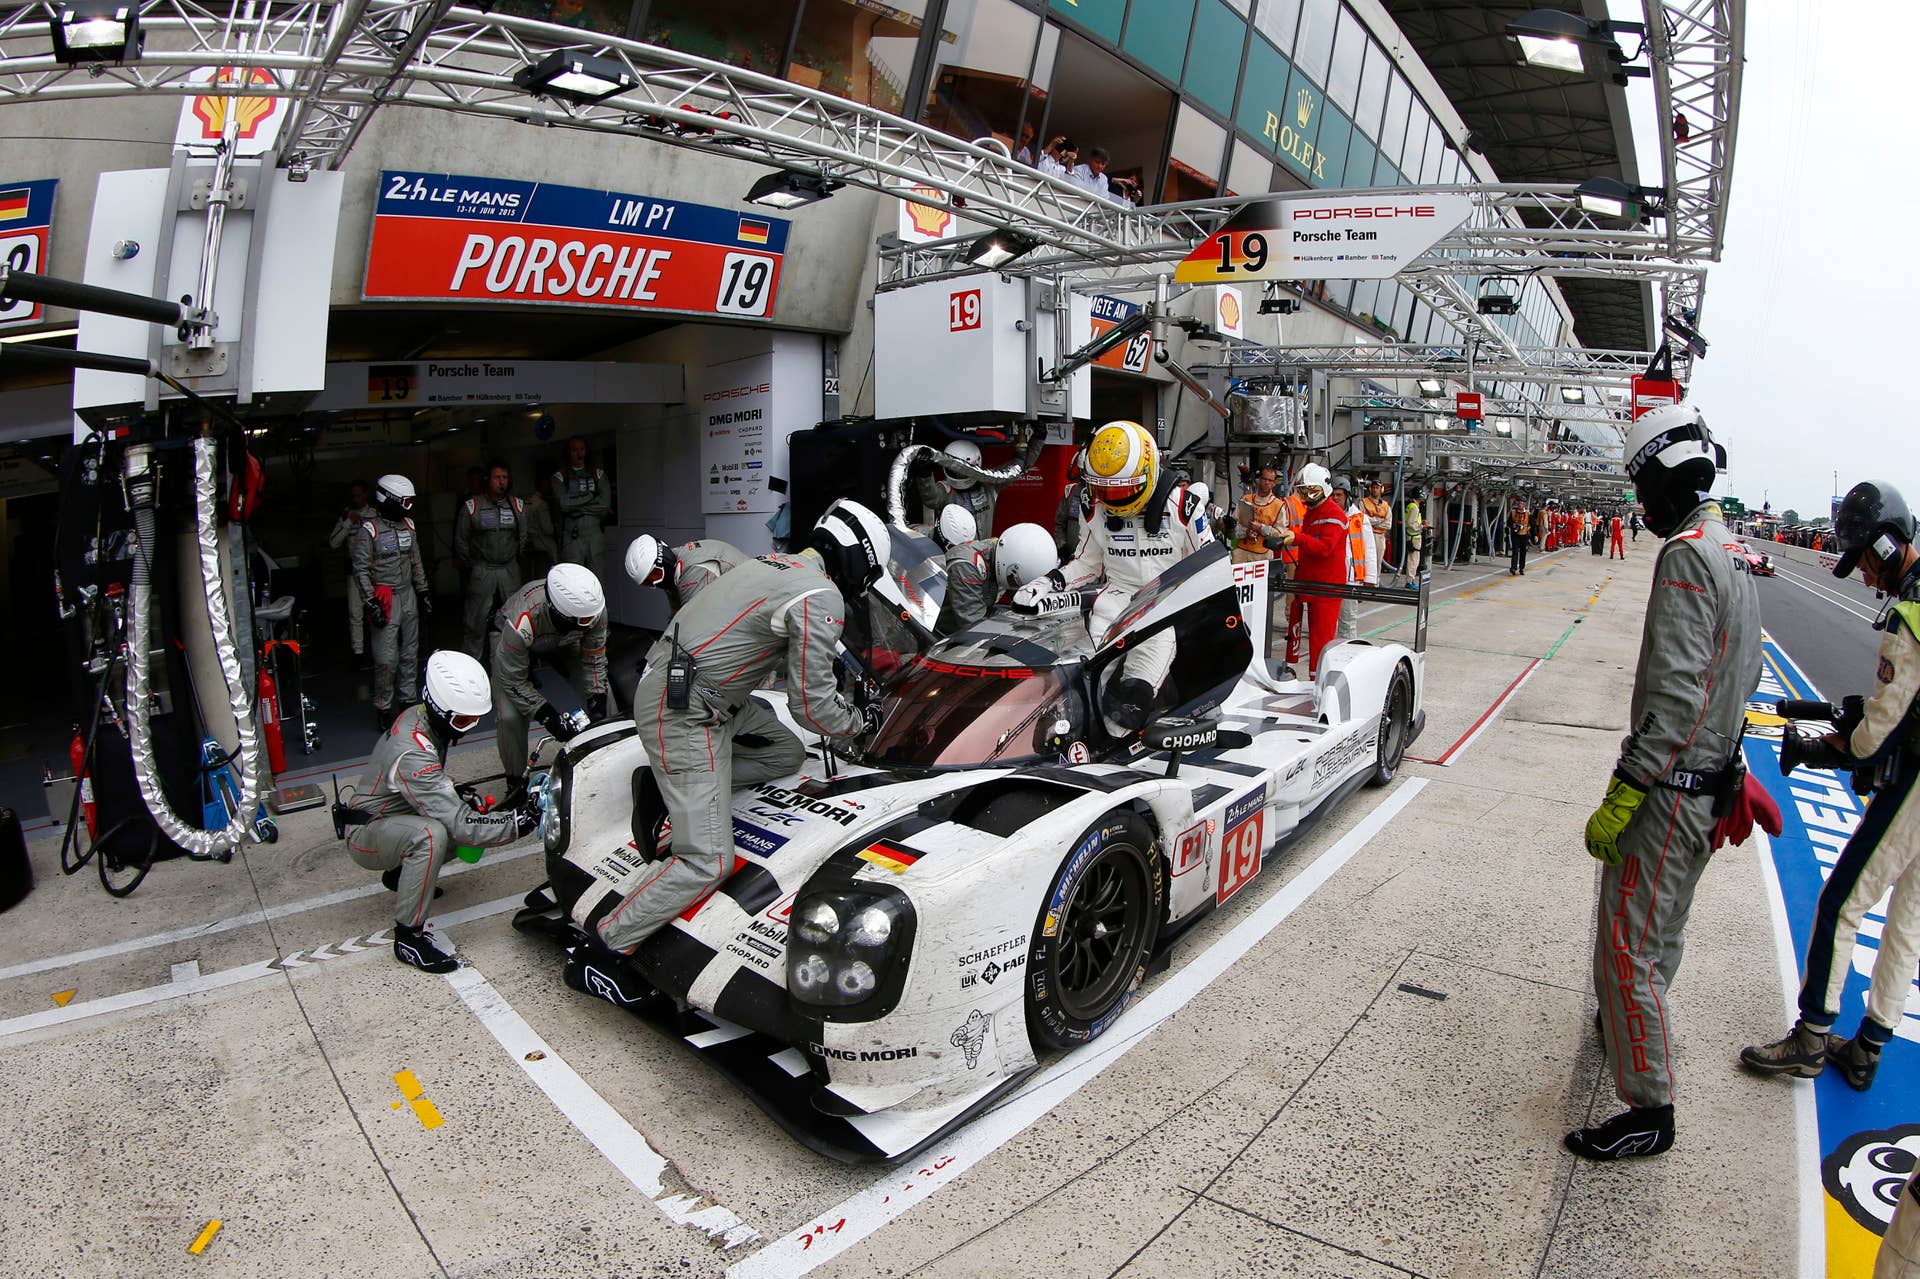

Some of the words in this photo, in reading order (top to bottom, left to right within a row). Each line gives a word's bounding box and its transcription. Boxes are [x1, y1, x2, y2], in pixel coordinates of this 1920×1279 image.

[1263, 111, 1327, 181] ROLEX
[385, 176, 428, 201] 24h
[430, 188, 459, 203] LE
[459, 190, 521, 208] MANS
[457, 205, 477, 214] 13-14
[480, 207, 495, 215] JUIN
[499, 208, 516, 217] 2015
[609, 199, 641, 228] LM
[645, 205, 675, 231] P1
[1293, 206, 1435, 221] PORSCHE
[1293, 230, 1341, 242] Porsche
[1345, 229, 1377, 241] Team
[1216, 233, 1268, 273] 19
[1380, 254, 1397, 262] Tandy
[450, 234, 672, 301] PORSCHE
[722, 260, 770, 309] 19
[950, 294, 980, 328] 19
[1113, 304, 1128, 321] AM
[1125, 338, 1148, 367] 62
[428, 364, 479, 378] Porsche
[483, 363, 515, 377] Team
[381, 378, 410, 401] 19
[704, 383, 770, 402] PORSCHE
[825, 380, 838, 393] 24
[524, 393, 542, 401] Tandy
[709, 413, 733, 426] DMG
[734, 408, 762, 423] MORI
[1628, 432, 1672, 476] uvex
[861, 538, 877, 568] uvex
[1107, 547, 1136, 557] DMG
[1140, 547, 1173, 558] MORI
[1669, 580, 1705, 595] vodafone
[1041, 593, 1070, 613] Mobil
[1162, 730, 1217, 748] CHOPARD
[748, 782, 791, 800] MG
[786, 794, 858, 827] MORI
[466, 817, 488, 825] DMG
[490, 813, 514, 825] MOR
[748, 806, 805, 826] WEC
[742, 832, 776, 850] MANS
[1181, 831, 1201, 868] P1
[611, 847, 637, 867] Mobil
[1147, 841, 1158, 867] FL
[1223, 820, 1259, 893] 19
[592, 865, 620, 884] CHOPARD
[1059, 836, 1098, 901] MICHELIN
[747, 920, 785, 943] Mobil
[726, 944, 770, 969] CHOPARD
[958, 934, 1026, 967] SCHAEFFLER
[1036, 944, 1046, 961] FL
[1003, 953, 1025, 973] FAG
[1612, 854, 1653, 1074] PORSCHE
[810, 1042, 857, 1062] DMG
[861, 1046, 918, 1062] MORI
